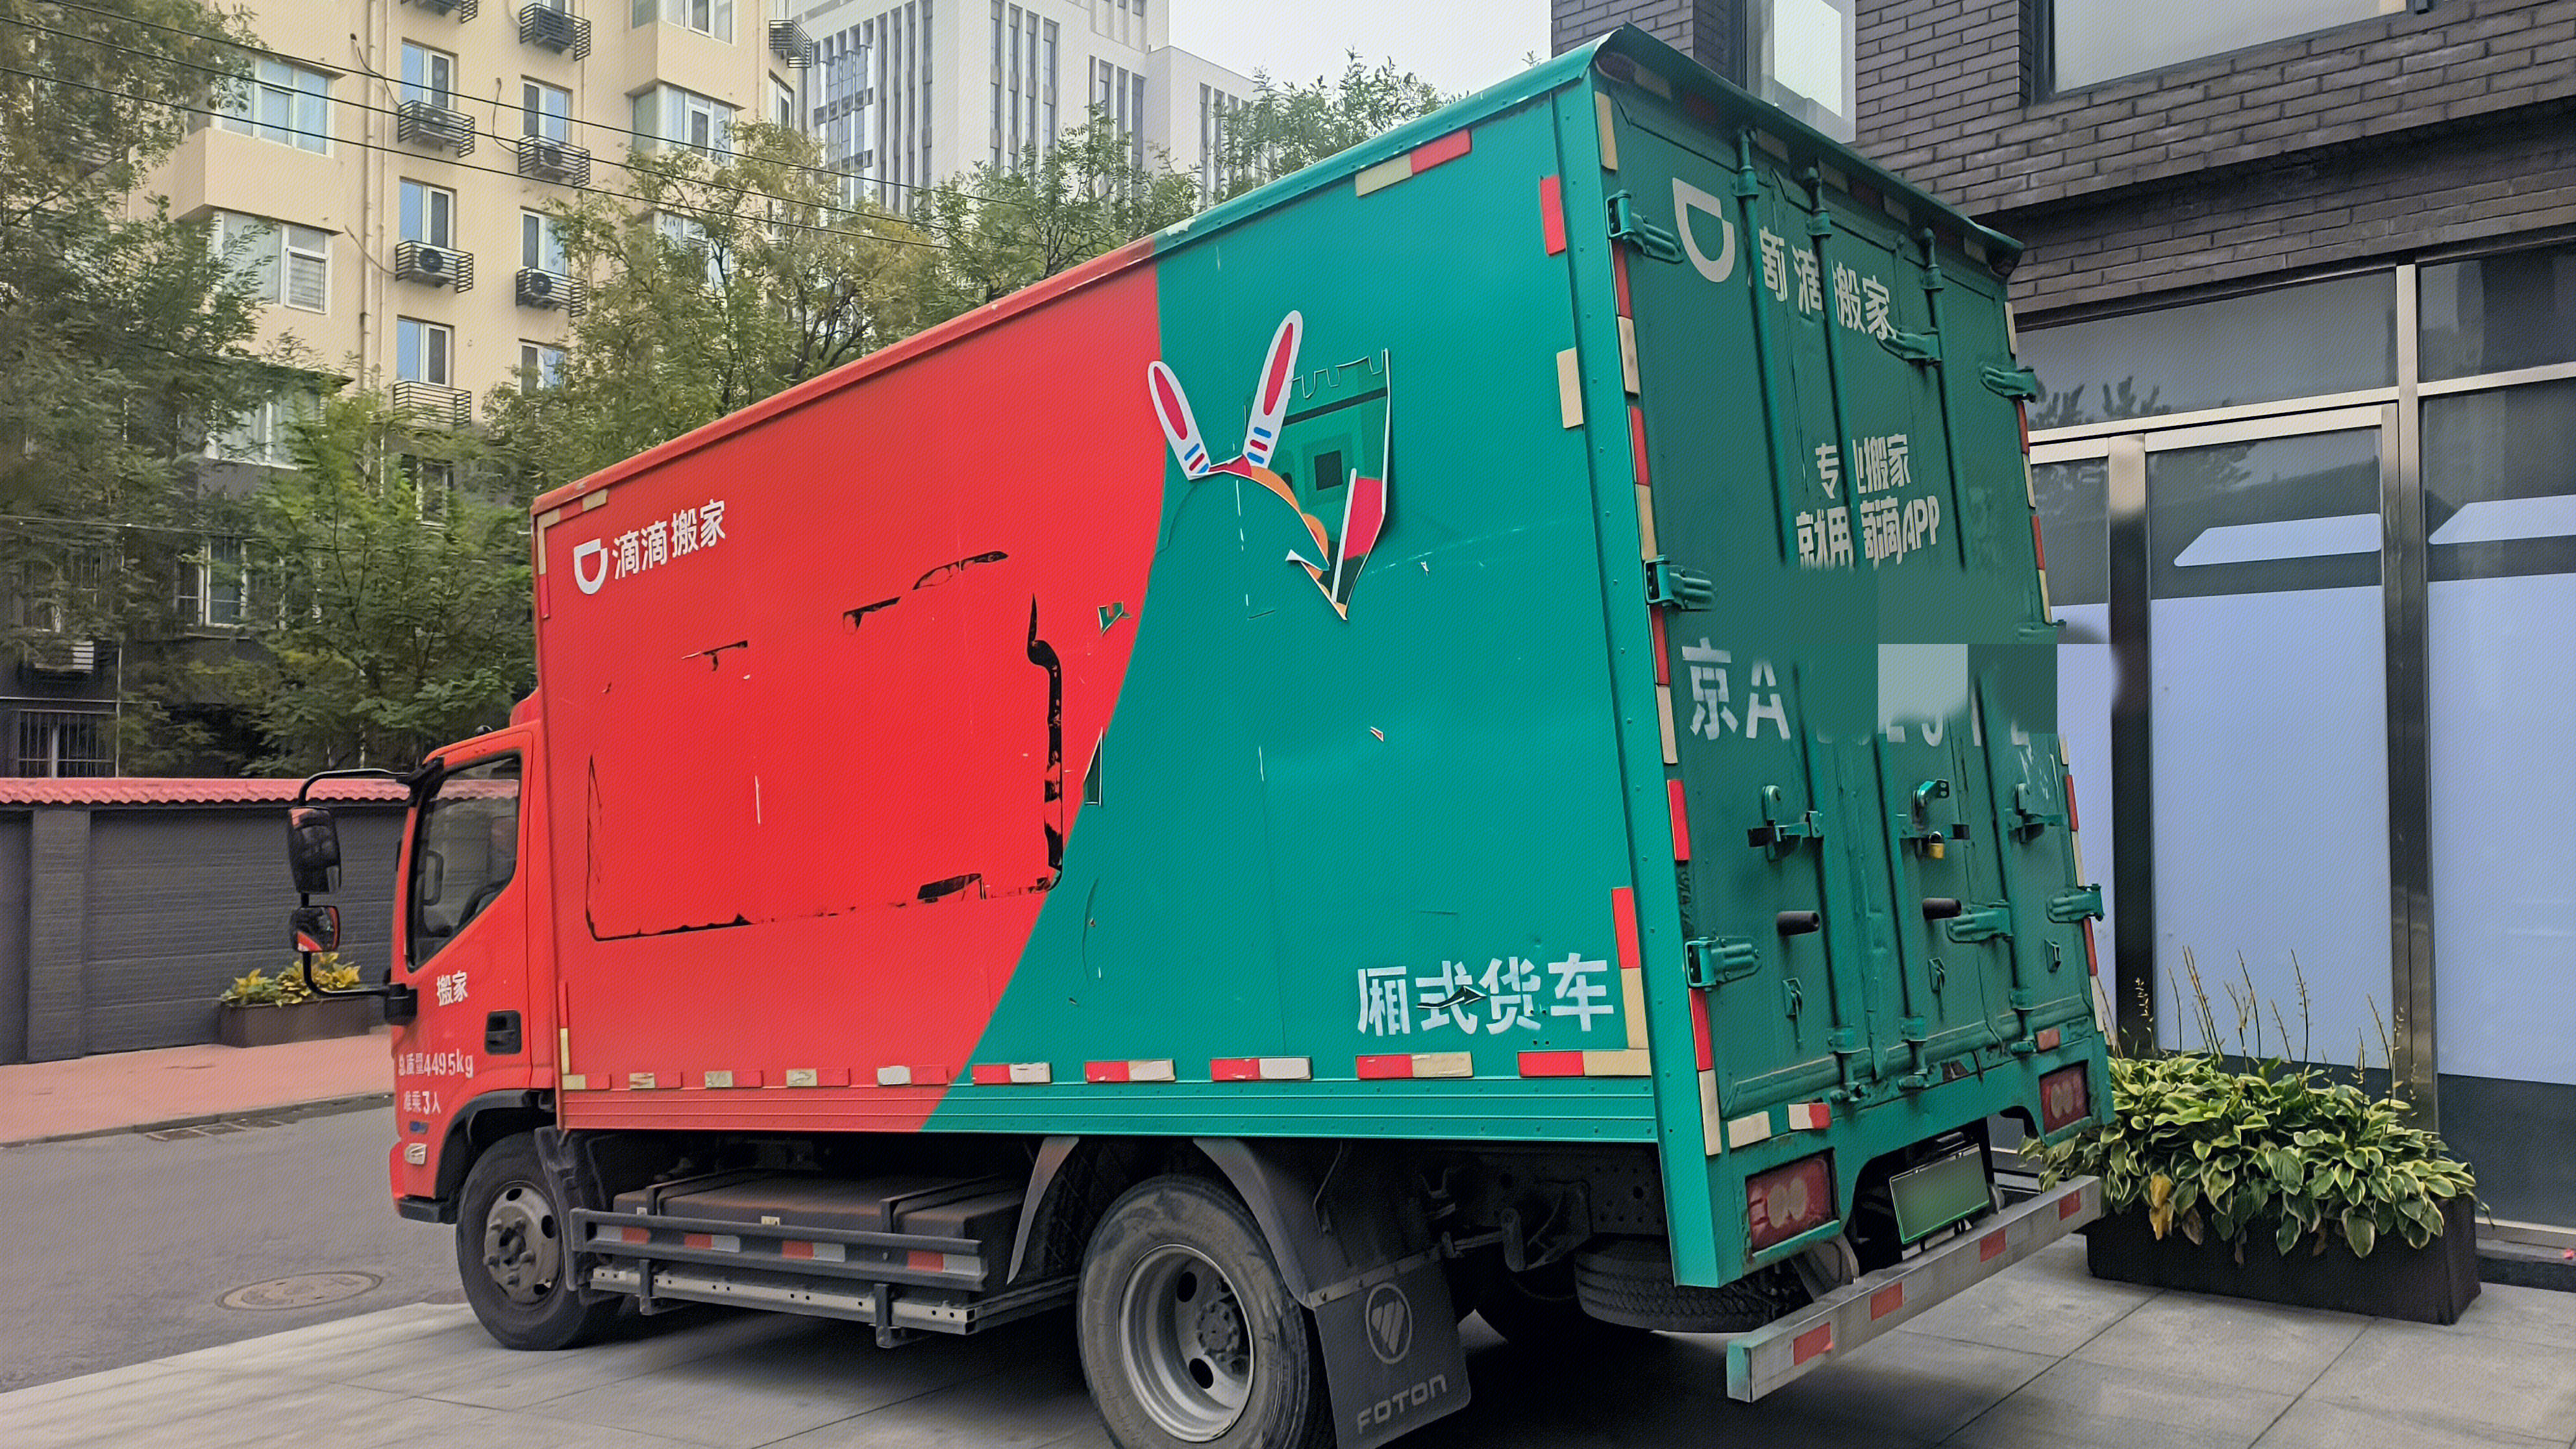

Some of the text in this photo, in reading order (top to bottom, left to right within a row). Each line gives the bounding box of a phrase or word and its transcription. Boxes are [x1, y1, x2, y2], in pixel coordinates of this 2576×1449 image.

[611, 498, 727, 580] 滴滴搬家
[436, 970, 469, 1007] 搬家
[1357, 952, 1615, 1037] 厢式货车
[1357, 1373, 1448, 1434] FOTON
